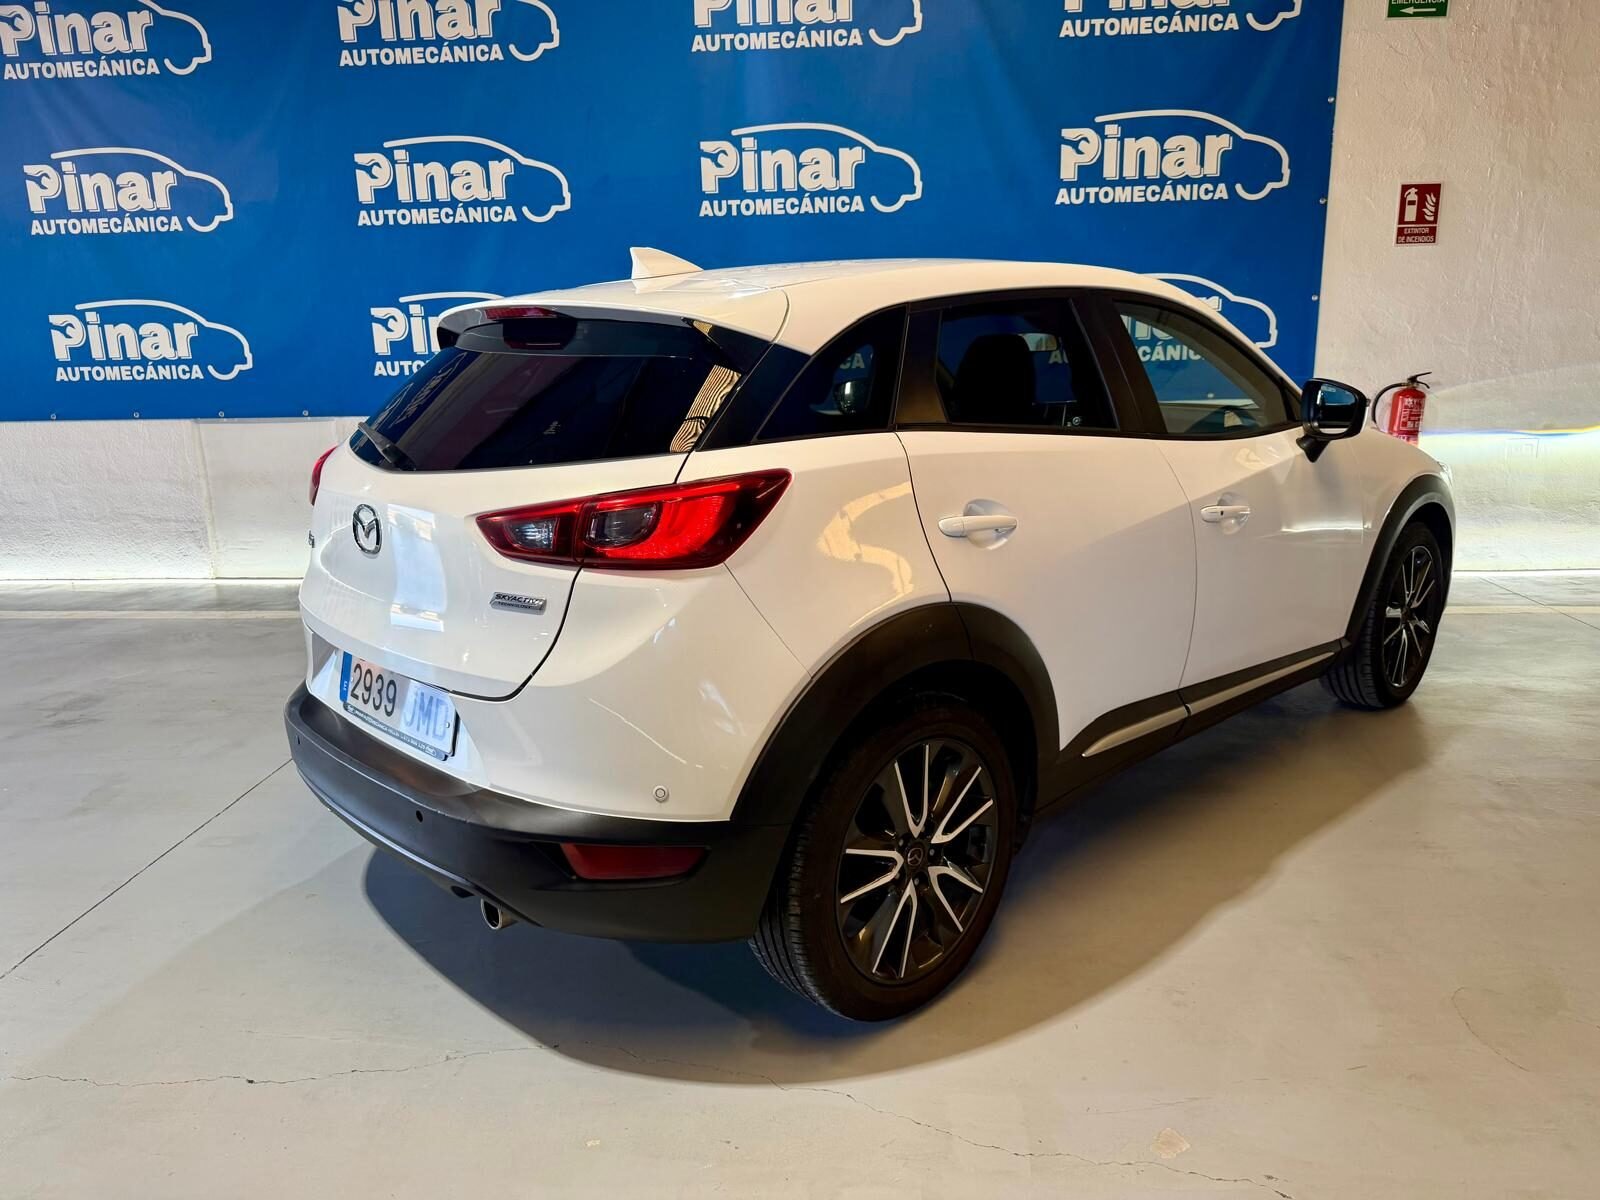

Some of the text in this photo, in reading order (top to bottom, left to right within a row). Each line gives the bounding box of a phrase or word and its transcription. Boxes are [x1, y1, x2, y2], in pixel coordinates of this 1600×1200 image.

[0, 1, 154, 56] Pinar
[337, 0, 502, 42] Pinar
[1059, 11, 1240, 37] AUTOMECÁNICA
[691, 26, 863, 52] AUTOMECÁNICA
[339, 41, 504, 67] AUTOMECÁNICA
[4, 56, 160, 80] AUTOMECÁNICA
[700, 137, 865, 194] Pinar
[1059, 124, 1233, 181] Pinar
[23, 161, 177, 214] Pinar
[354, 149, 514, 204] Pinar
[699, 194, 865, 217] AUTOMECÁNICA
[1055, 180, 1229, 205] AUTOMECÁNICA
[31, 213, 183, 236] AUTOMECÁNICA
[357, 203, 517, 226] AUTOMECÁNICA
[48, 311, 198, 361] Pinar
[55, 361, 204, 382] AUTOMECÁNICA
[350, 663, 397, 717] 2939
[403, 687, 450, 741] JMD
